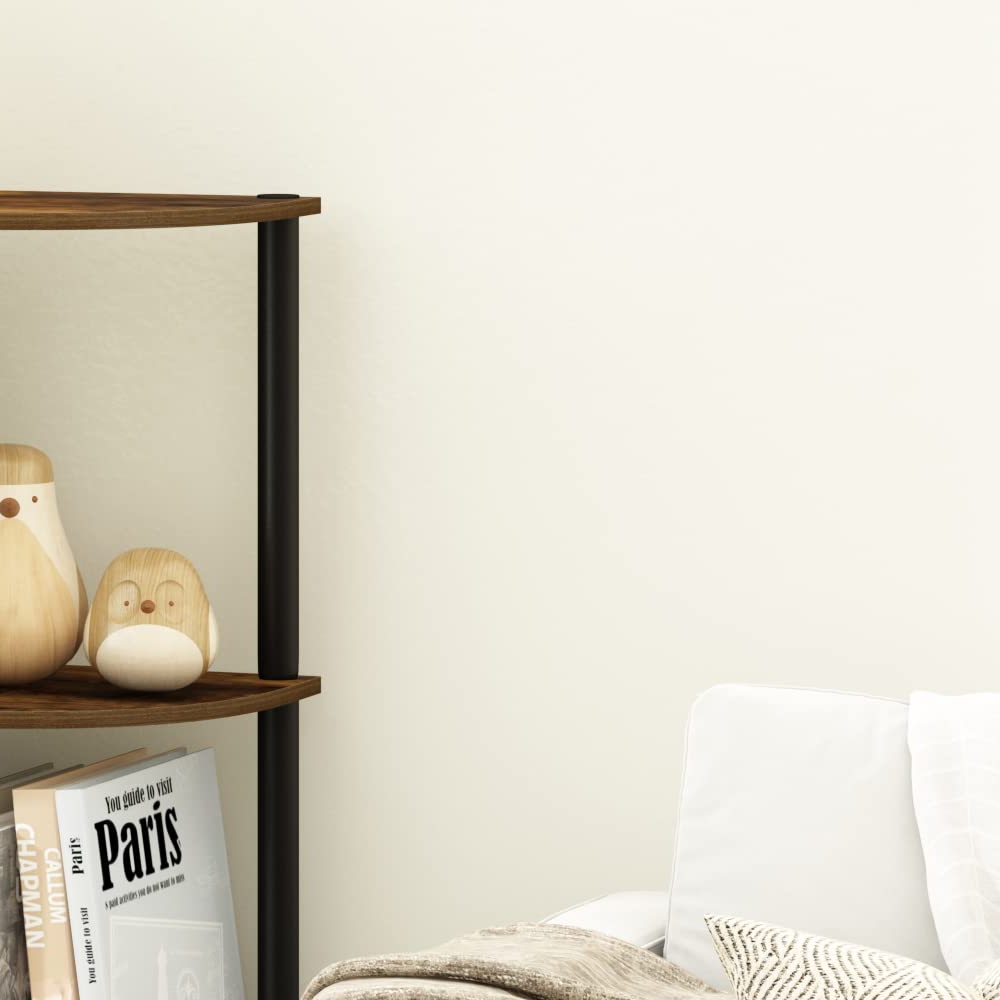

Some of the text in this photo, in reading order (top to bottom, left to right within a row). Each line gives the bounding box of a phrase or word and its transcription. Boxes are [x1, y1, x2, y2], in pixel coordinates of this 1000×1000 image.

[105, 777, 173, 814] You guide to visit
[69, 837, 85, 875] Paris
[94, 800, 182, 891] Paris
[15, 823, 45, 948] CHAPMAN
[44, 847, 67, 924] CALLUM
[80, 907, 97, 984] You guide to visit
